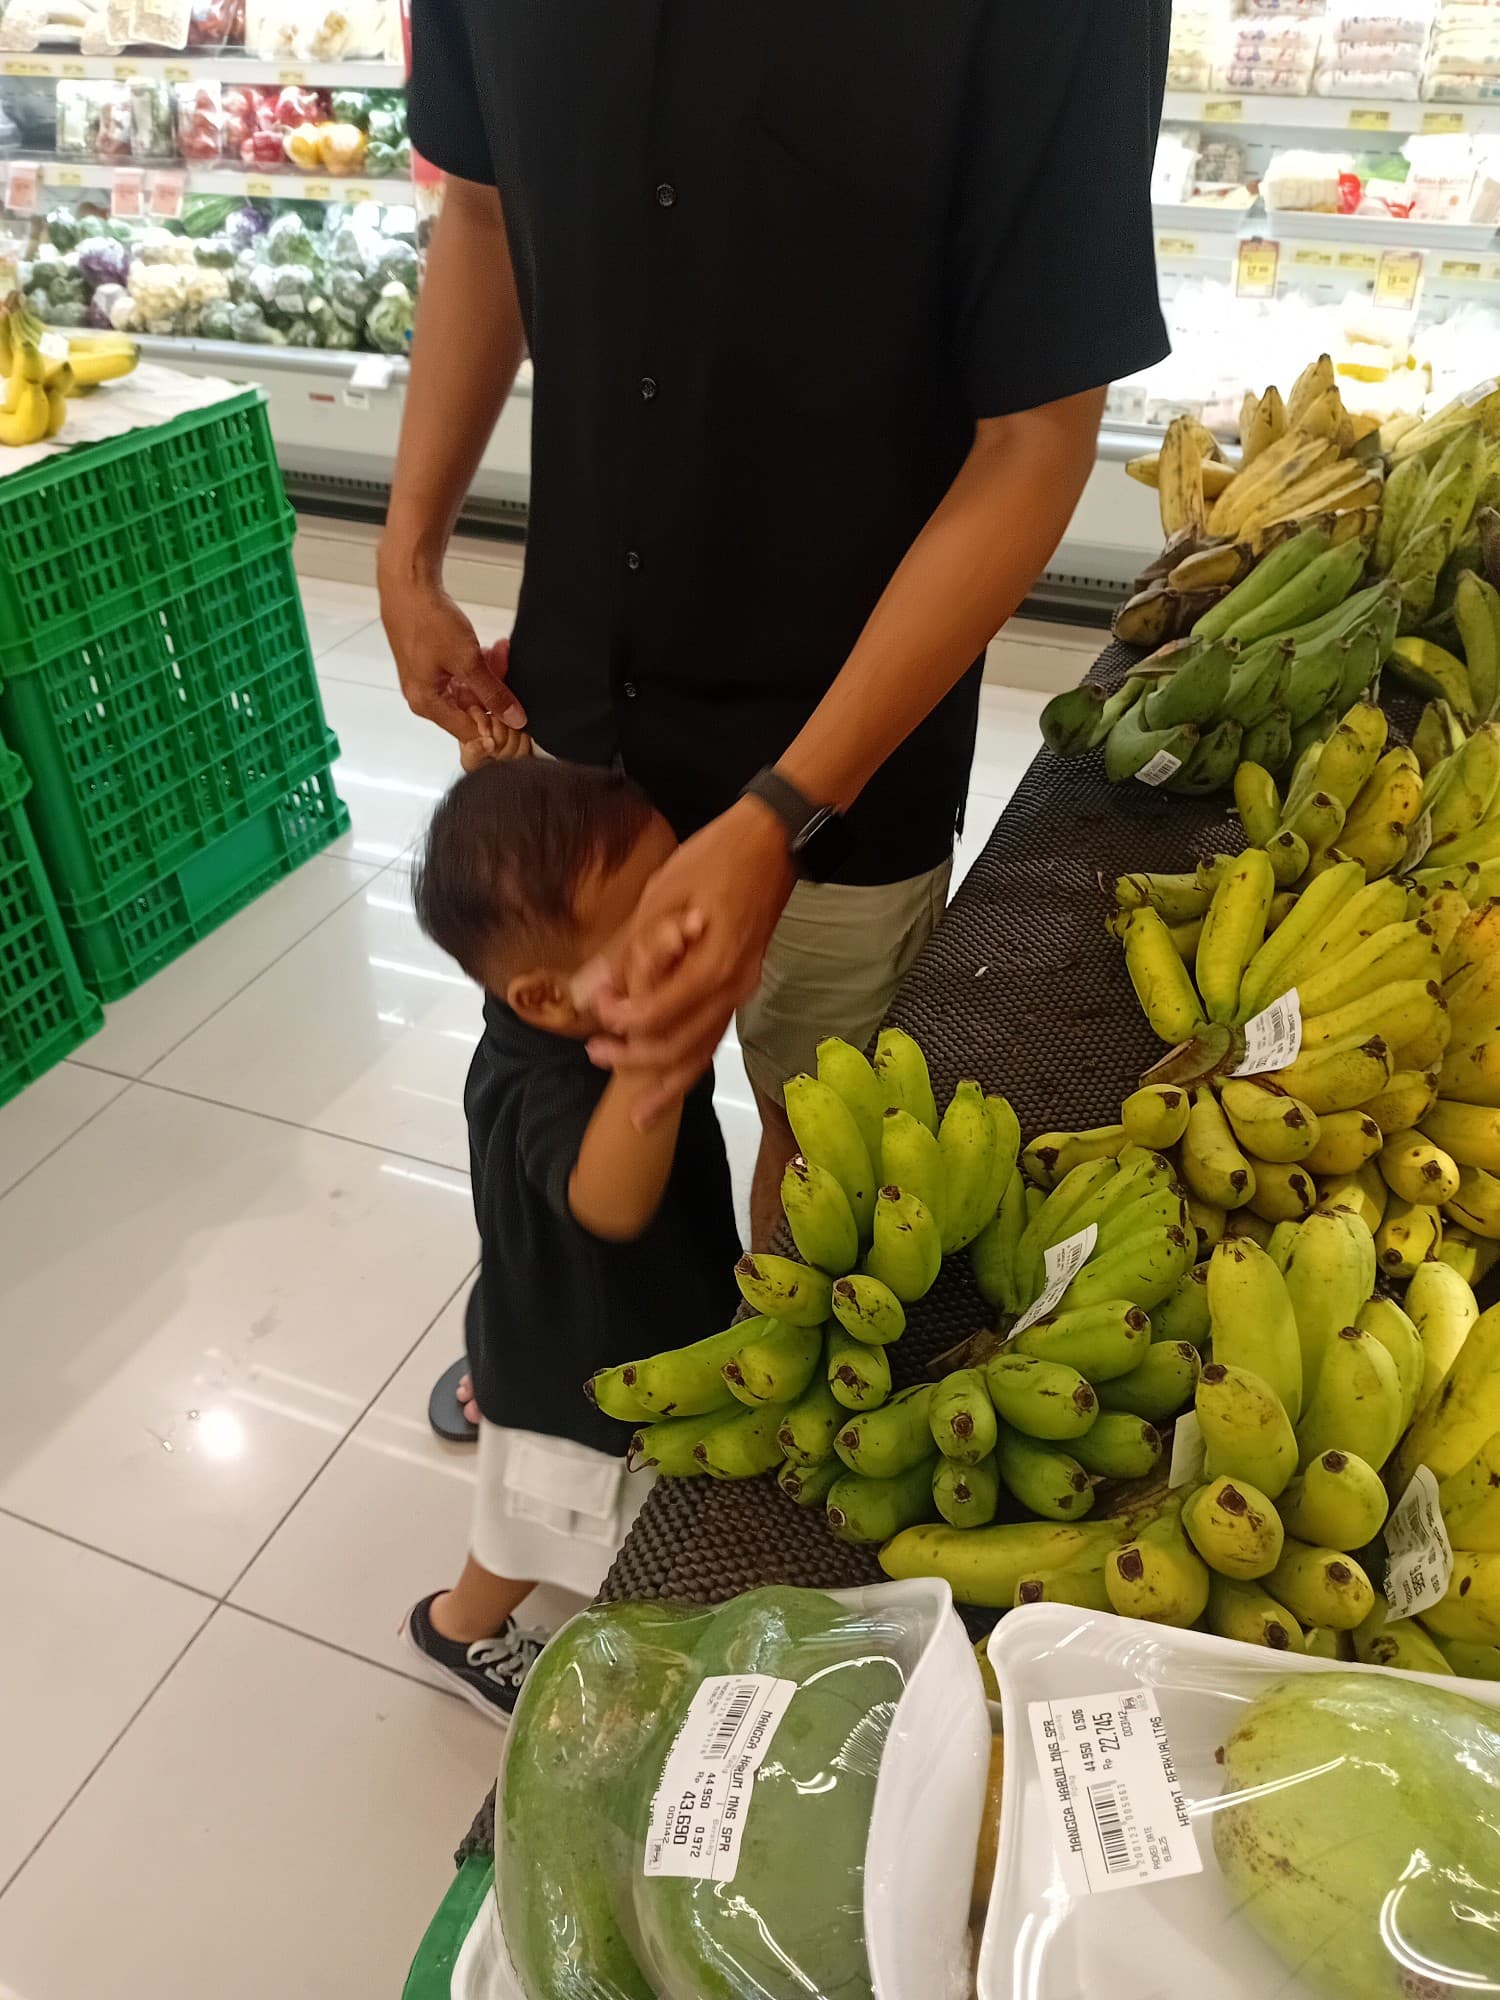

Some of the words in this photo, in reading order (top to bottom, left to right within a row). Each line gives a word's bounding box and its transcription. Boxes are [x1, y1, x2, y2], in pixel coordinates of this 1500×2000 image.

[746, 1710, 773, 1750] MANGGA
[1043, 1719, 1057, 1740] SPR
[1092, 1712, 1121, 1753] 22.745
[1048, 1742, 1062, 1763] MNS
[1102, 1758, 1113, 1770] Rp
[732, 1755, 753, 1789] HARUM
[1053, 1765, 1071, 1802] HARUM
[662, 1805, 676, 1844] 003142
[673, 1791, 697, 1845] 43.690
[725, 1795, 739, 1820] MNS
[719, 1826, 733, 1852] SPR
[1063, 1808, 1083, 1853] MANGGA
